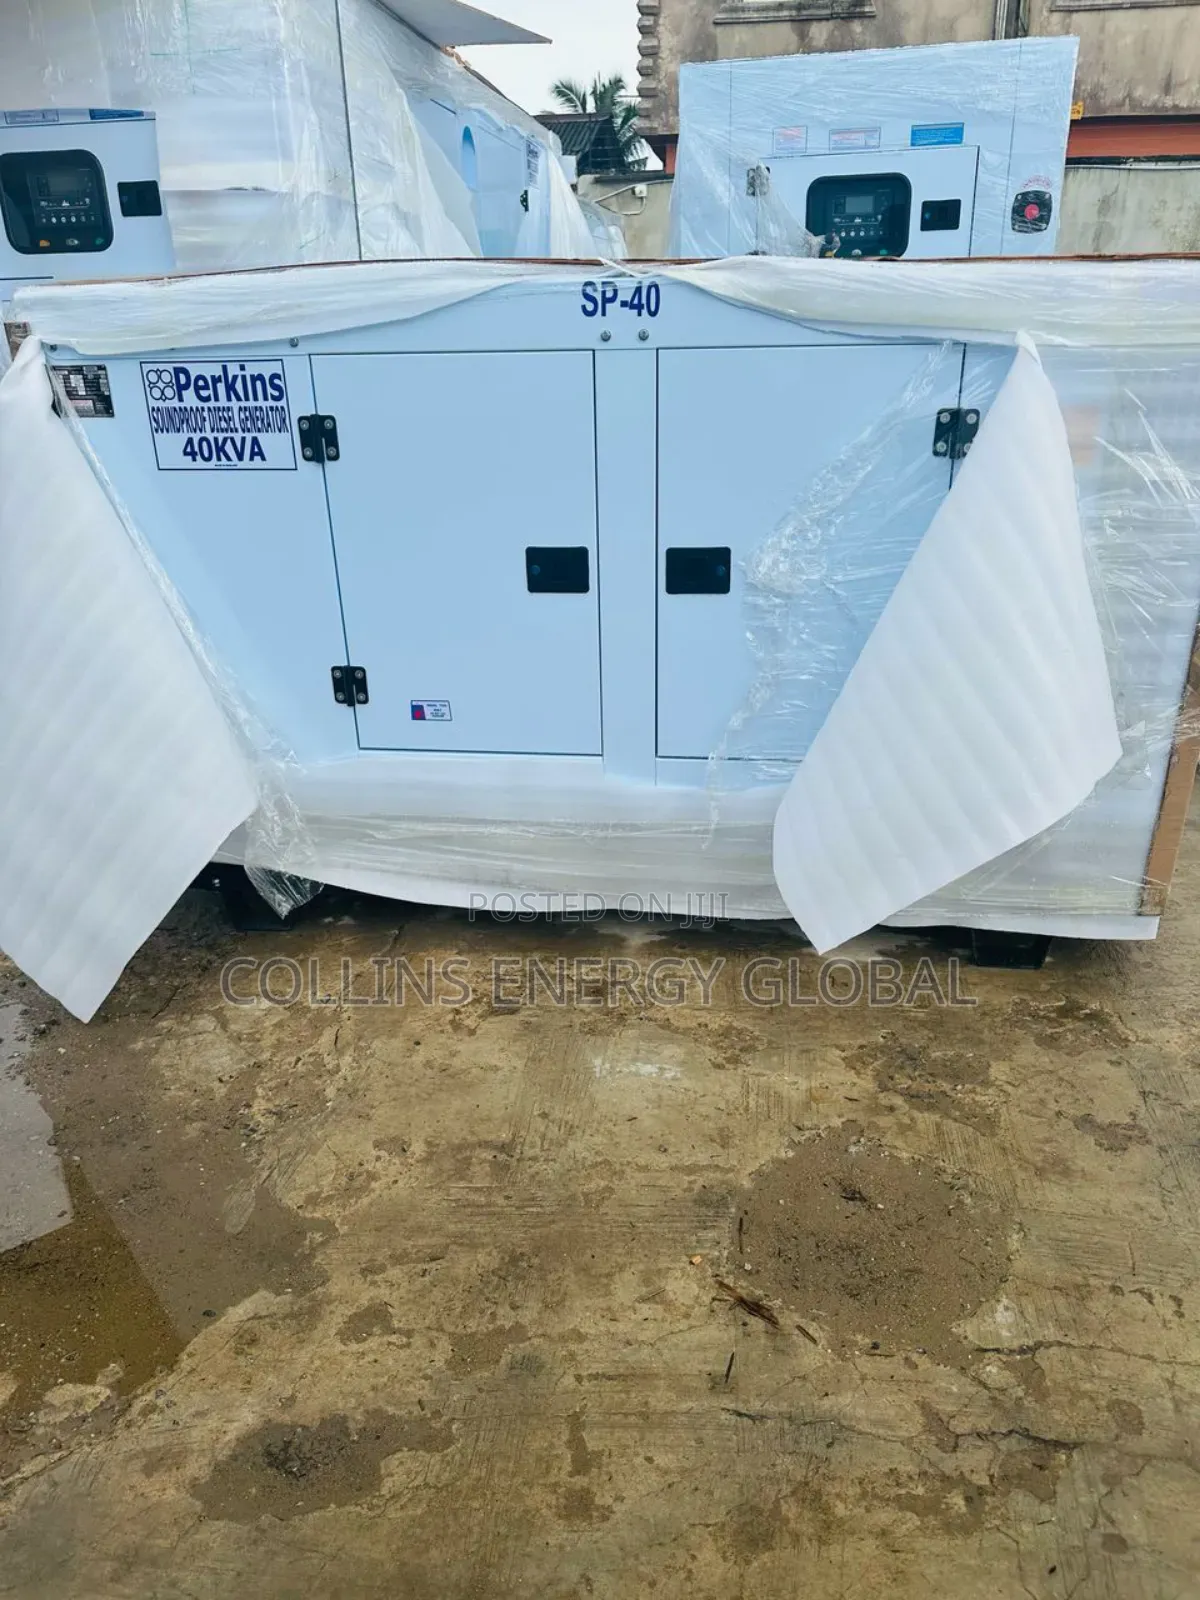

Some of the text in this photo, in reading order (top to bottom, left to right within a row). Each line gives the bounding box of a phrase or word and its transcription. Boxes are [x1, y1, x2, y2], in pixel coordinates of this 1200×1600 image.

[581, 280, 661, 317] SP-40
[173, 364, 285, 403] Perkins
[151, 405, 289, 434] SOUNDPROOF DIESEL GENERATOR
[182, 435, 267, 463] 40KVA
